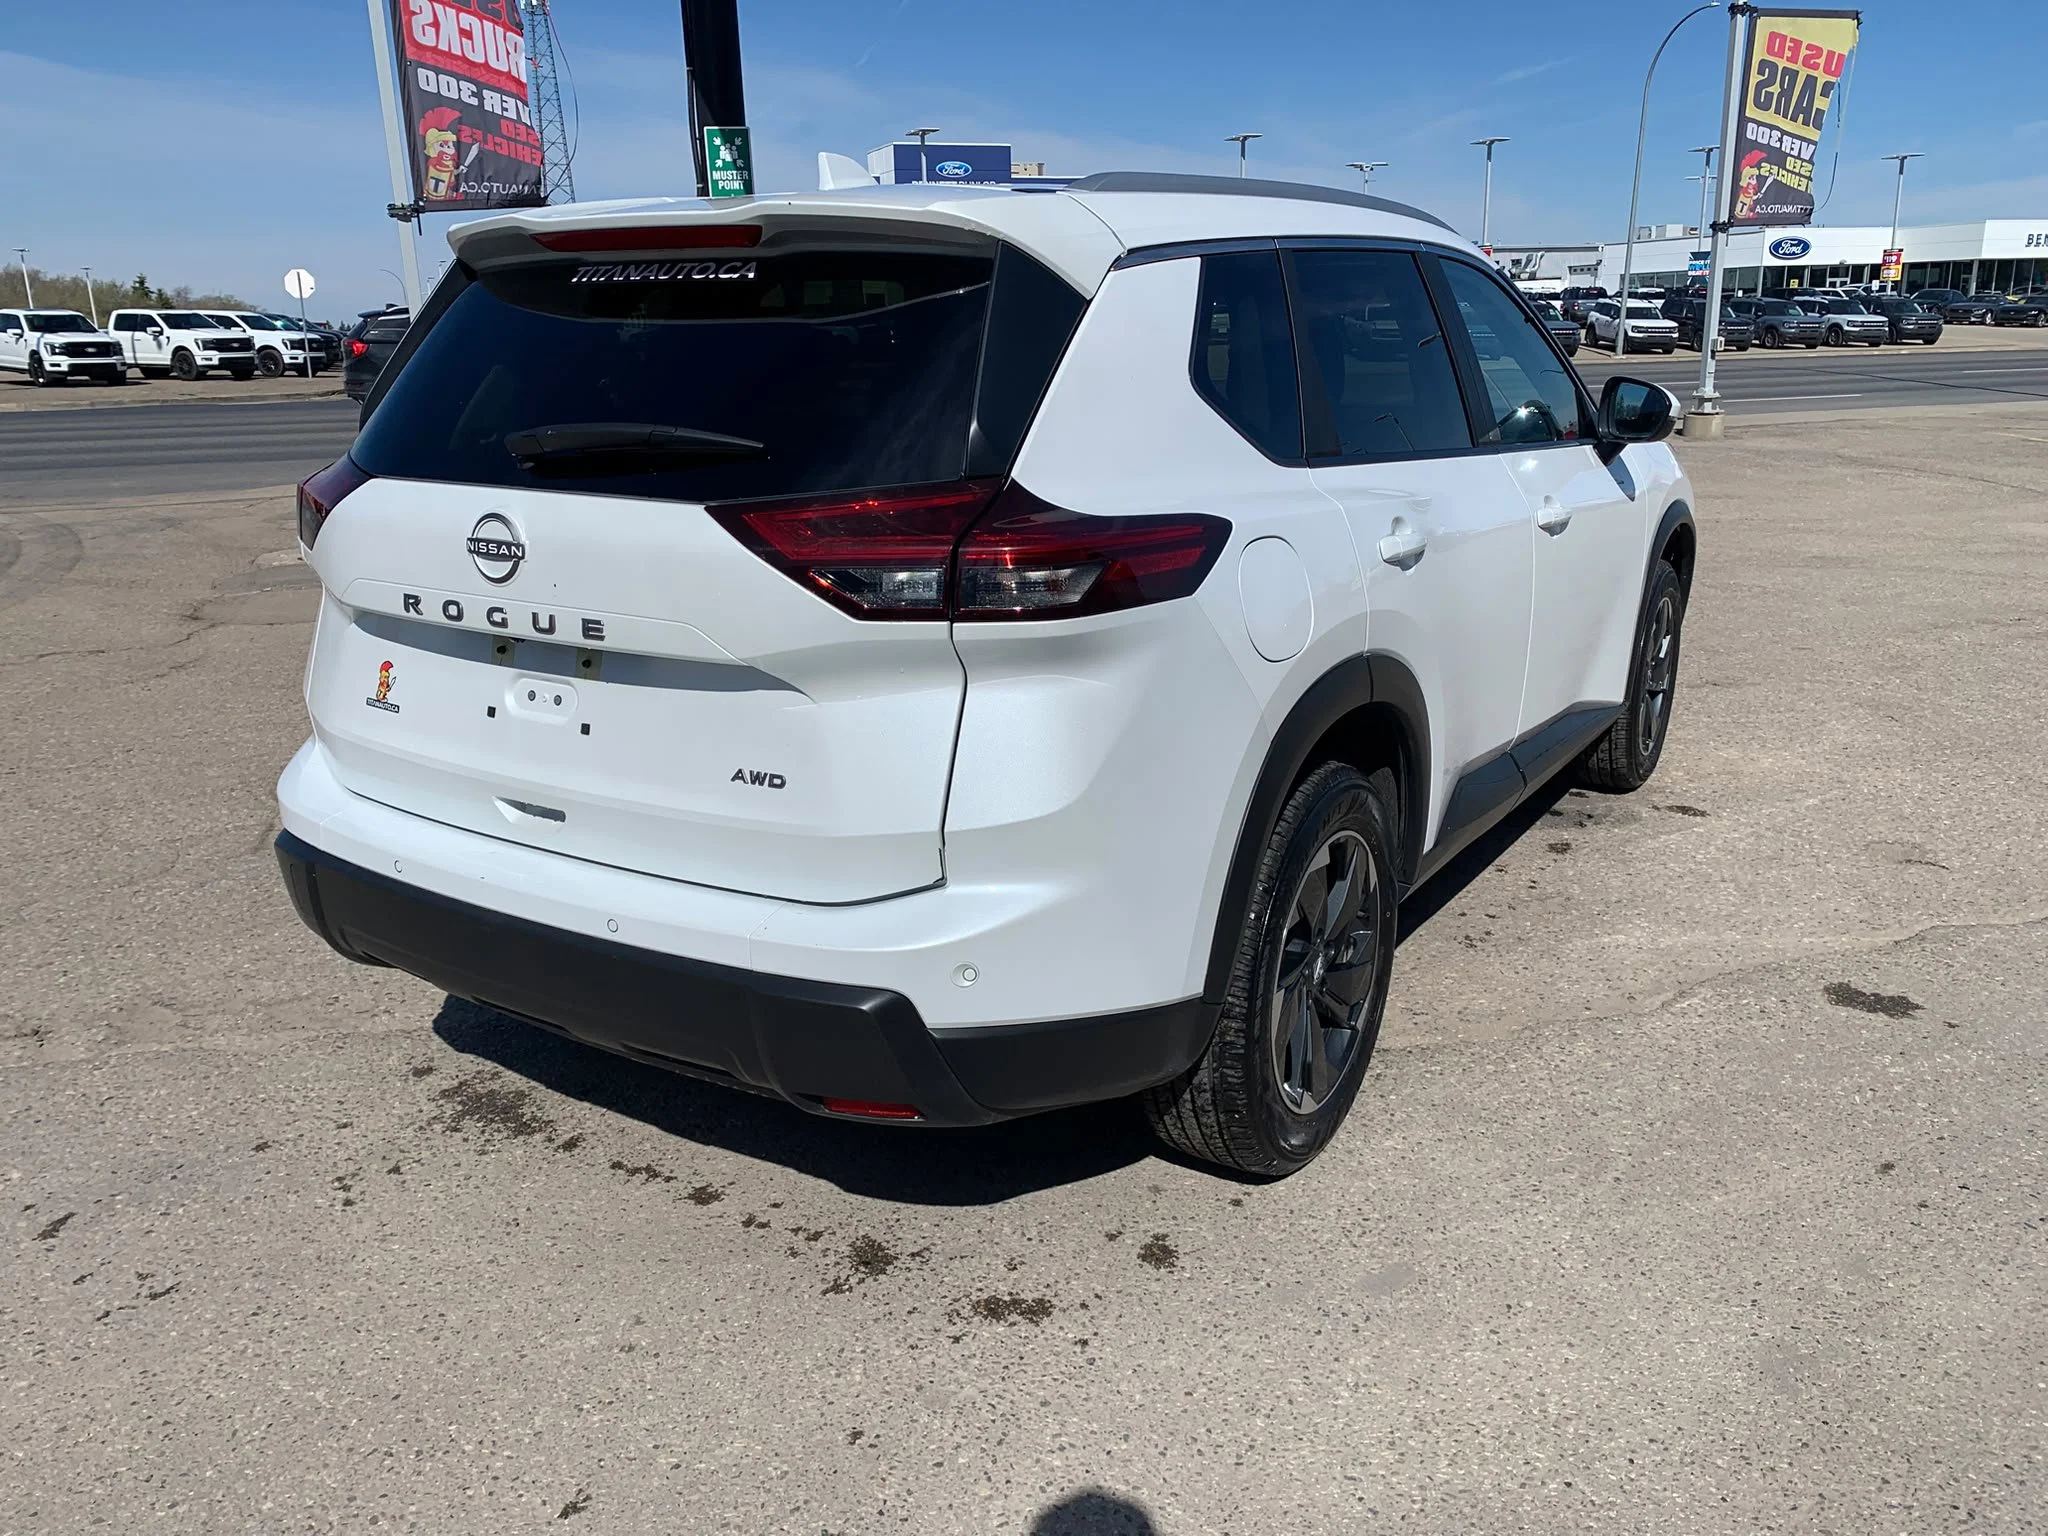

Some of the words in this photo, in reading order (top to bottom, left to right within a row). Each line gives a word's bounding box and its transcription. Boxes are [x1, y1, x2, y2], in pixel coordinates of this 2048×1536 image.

[712, 170, 749, 180] MUSTER
[718, 180, 745, 190] POINT
[571, 262, 757, 282] TITANAUTO.CA
[467, 540, 523, 557] NISSAN
[403, 593, 606, 641] ROGUE
[730, 768, 787, 790] AWD
